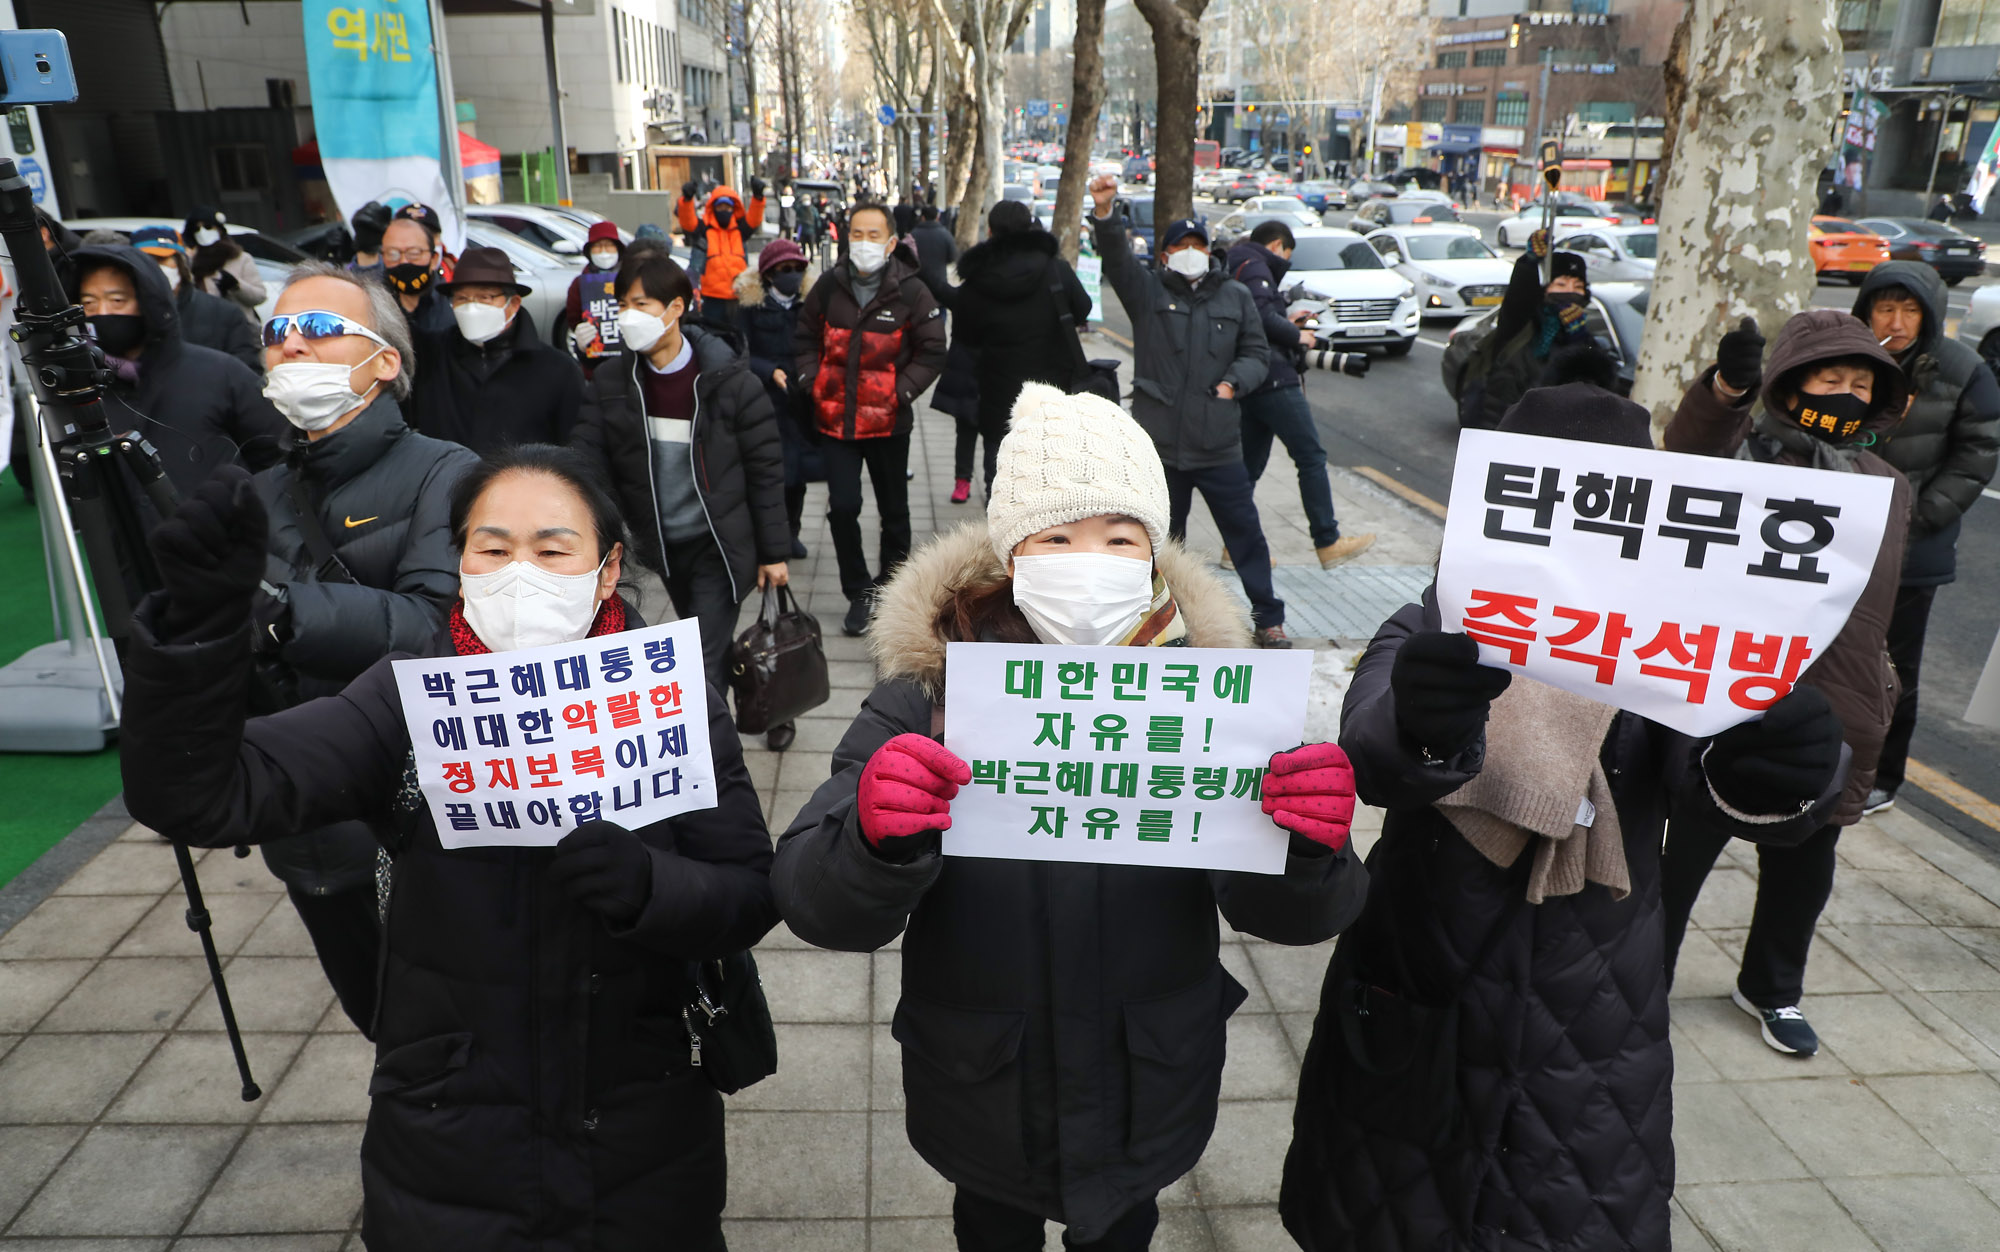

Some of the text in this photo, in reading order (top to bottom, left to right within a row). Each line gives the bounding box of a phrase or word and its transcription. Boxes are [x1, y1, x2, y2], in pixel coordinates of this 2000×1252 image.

[1800, 407, 1838, 433] 탄핵
[1484, 462, 1841, 584] 탄핵무효
[422, 637, 676, 706] 박근혜대통령
[1462, 589, 1812, 711] 즉각석방
[1004, 660, 1253, 703] 대한민국에
[1032, 712, 1214, 752] 자유를!
[971, 759, 1271, 802] 박근혜대통령께
[1027, 806, 1203, 842] 자유를!
